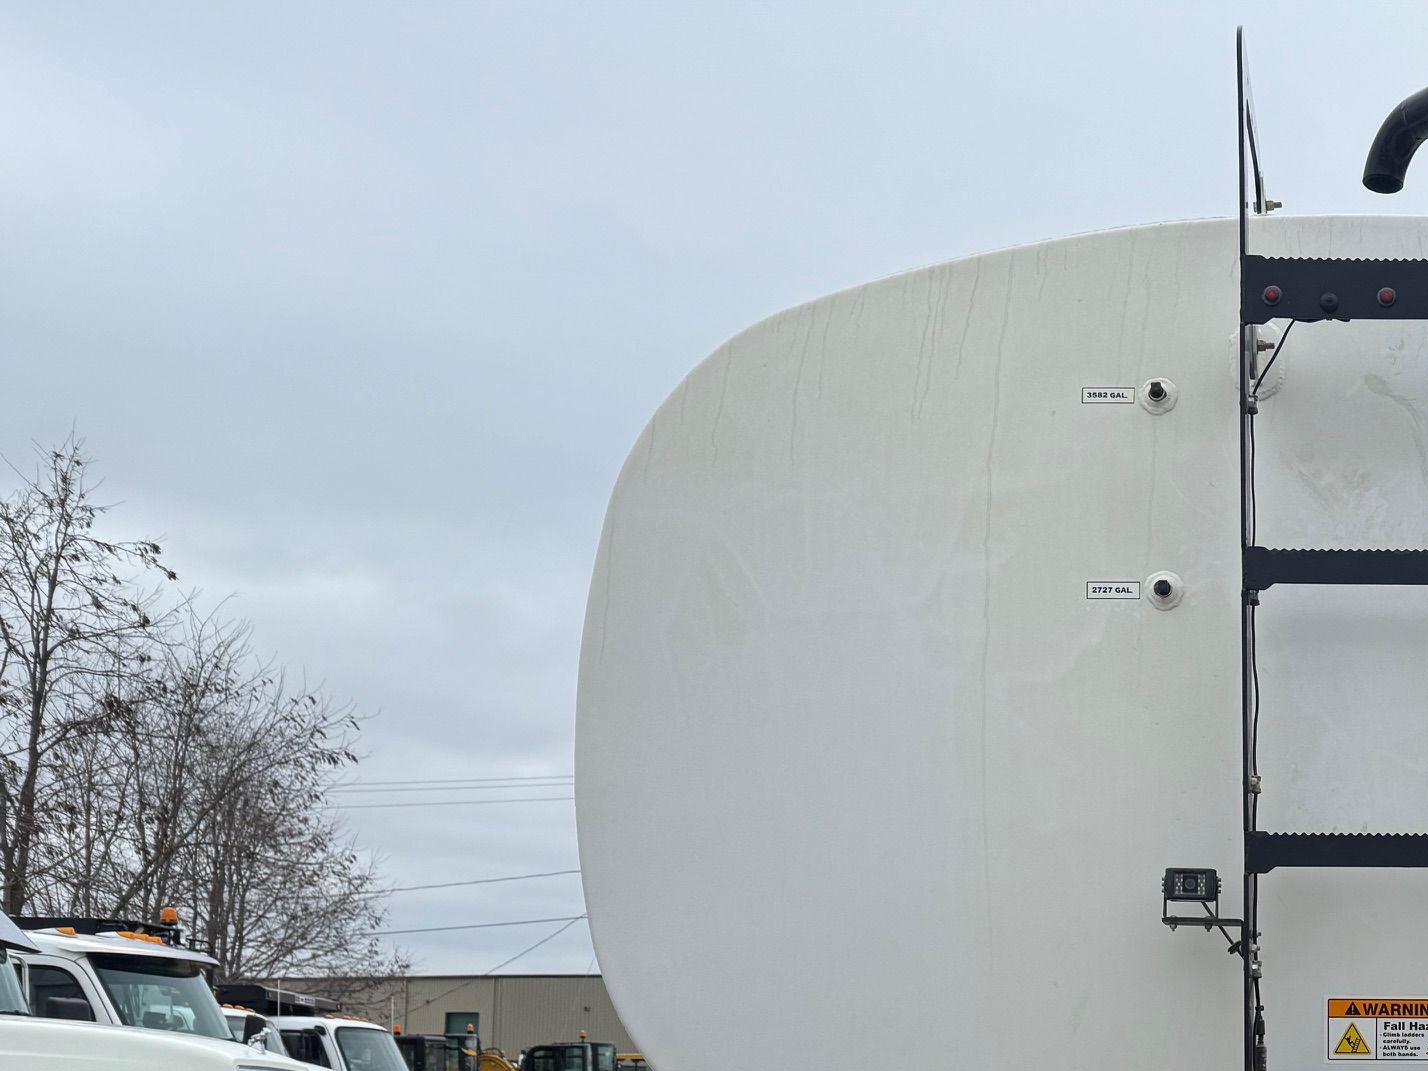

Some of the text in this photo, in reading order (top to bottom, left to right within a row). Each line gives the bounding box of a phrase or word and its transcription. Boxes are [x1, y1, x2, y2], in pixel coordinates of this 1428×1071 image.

[1086, 391, 1108, 399] 3582
[1091, 586, 1113, 594] 2727
[1383, 1021, 1405, 1031] Fall
